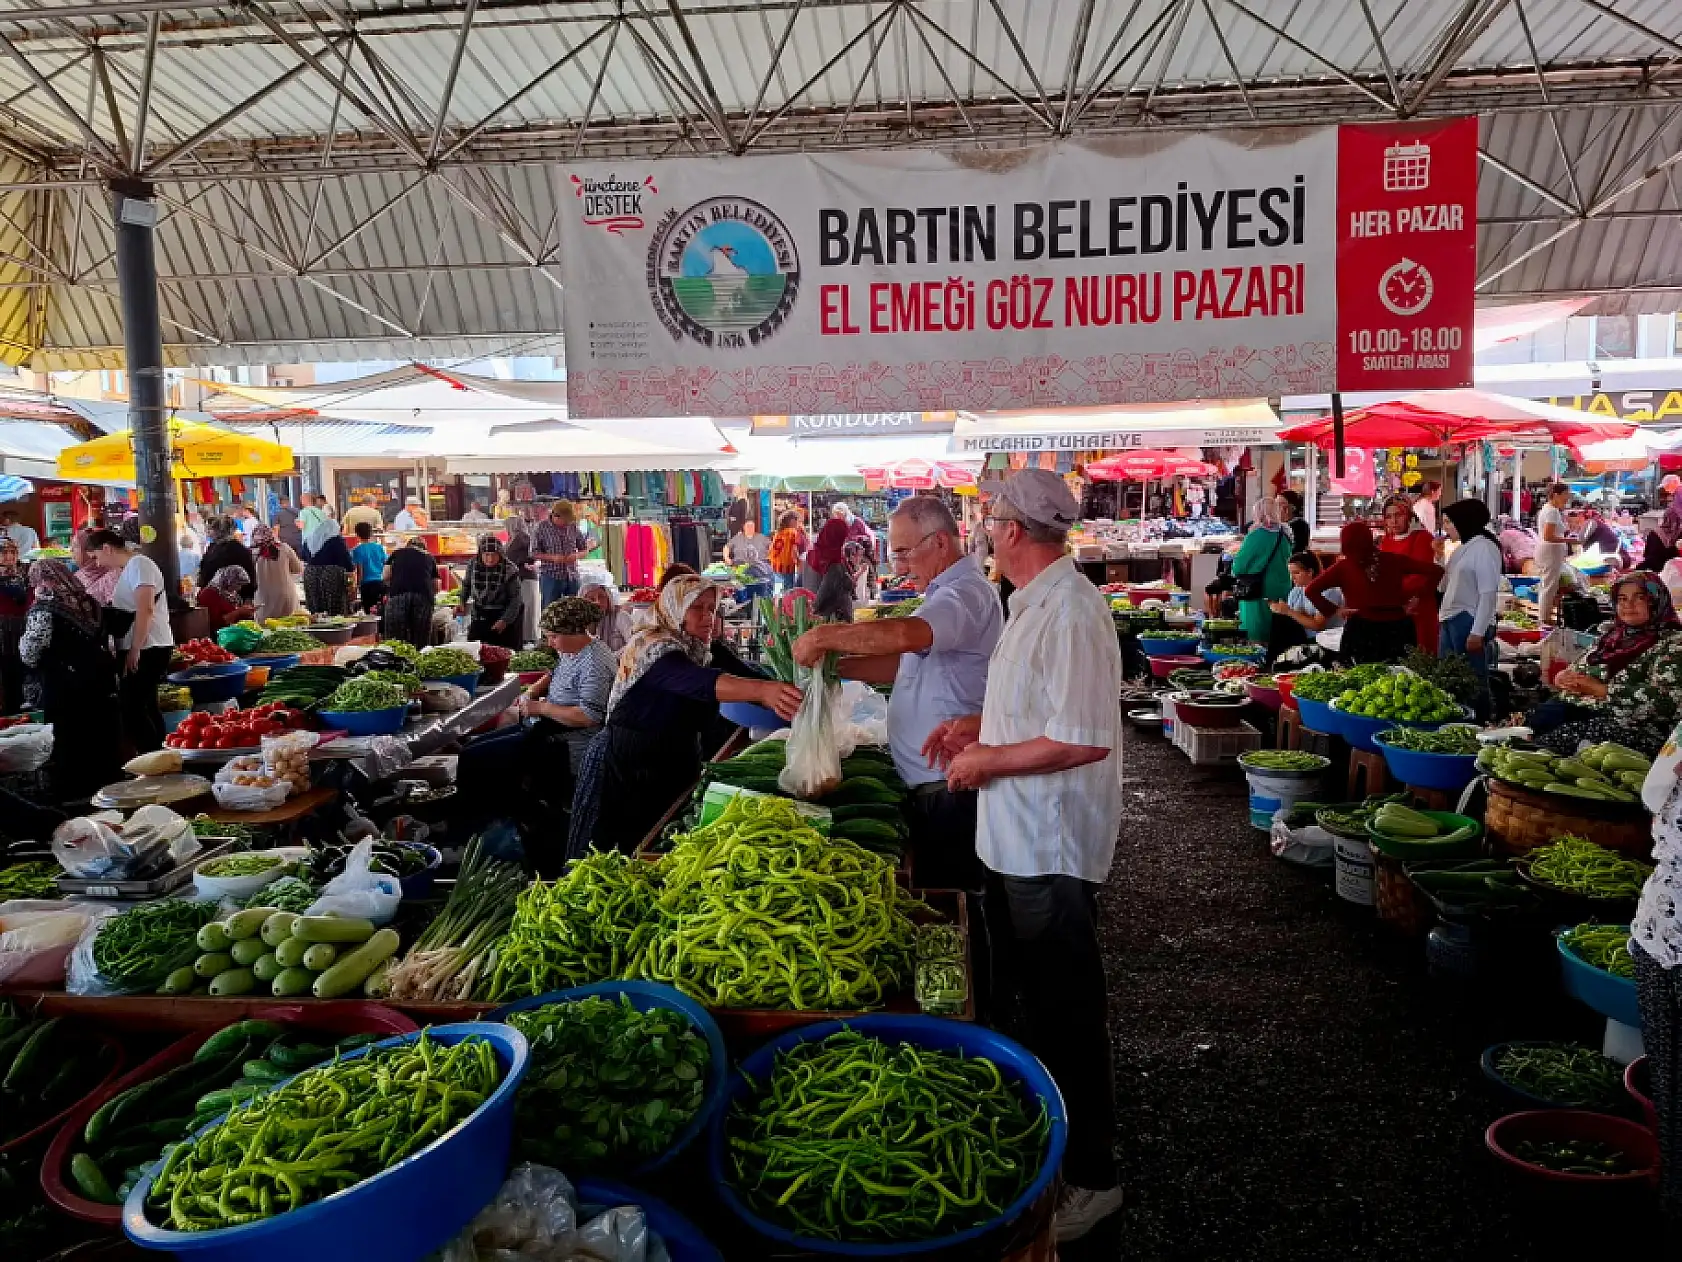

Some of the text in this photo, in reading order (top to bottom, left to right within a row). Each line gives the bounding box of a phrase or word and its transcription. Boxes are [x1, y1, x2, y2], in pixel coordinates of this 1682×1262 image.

[585, 194, 642, 215] DESTEK
[819, 174, 1305, 266] BARTIN BELEDİYESİ
[1350, 204, 1463, 238] HER PAZAR
[820, 284, 860, 335] EL
[987, 274, 1054, 330] GÖZ
[1065, 271, 1162, 328] NURU
[1173, 262, 1304, 322] PAZARI
[1349, 327, 1462, 353] 10.00-18.00
[1363, 352, 1449, 371] SAATLERİ ARASI
